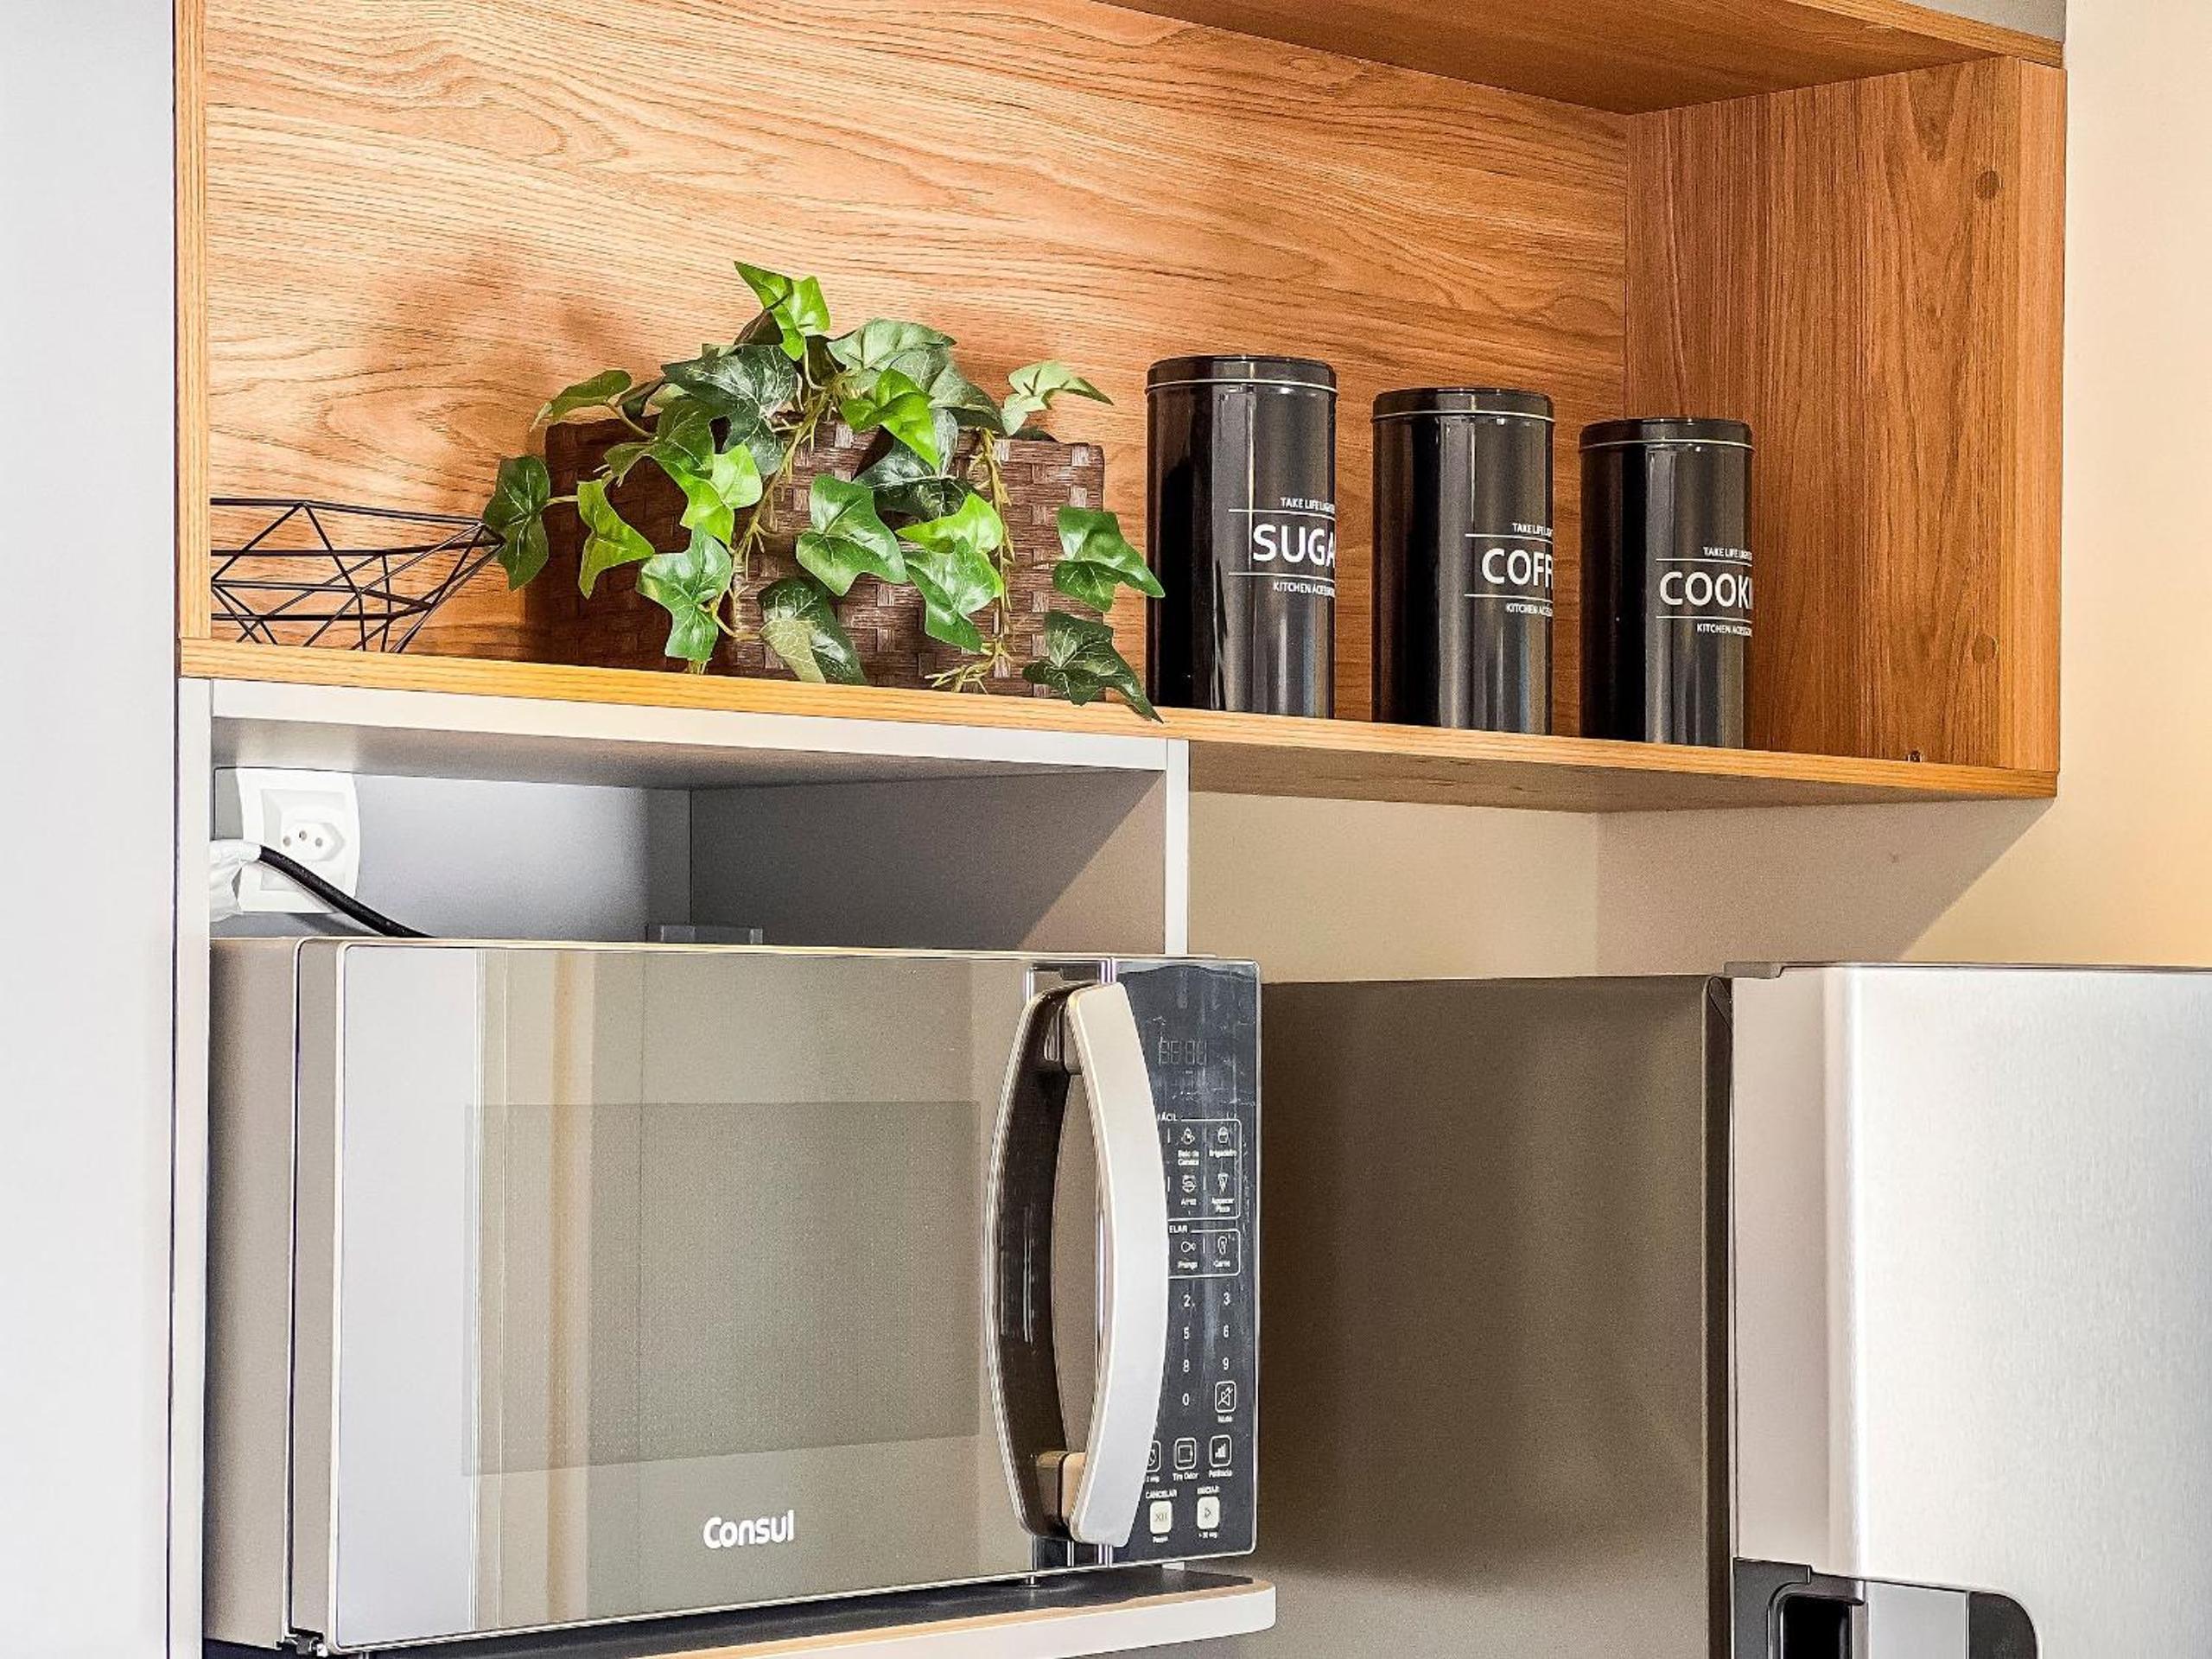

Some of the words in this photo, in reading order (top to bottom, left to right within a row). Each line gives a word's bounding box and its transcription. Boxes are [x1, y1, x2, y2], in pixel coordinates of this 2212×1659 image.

[1280, 497, 1303, 508] TAKE
[1702, 546, 1724, 556] TAKE
[1273, 582, 1312, 594] KITCHEN
[1696, 623, 1731, 633] KITCHEN
[1184, 1294, 1191, 1307] 2
[1224, 1293, 1230, 1306] 3
[1184, 1326, 1190, 1339] 5
[1223, 1325, 1230, 1338] 6
[1183, 1359, 1190, 1372] 8
[1223, 1357, 1230, 1370] 9
[1182, 1393, 1190, 1406] 0
[703, 1510, 794, 1549] Consul
